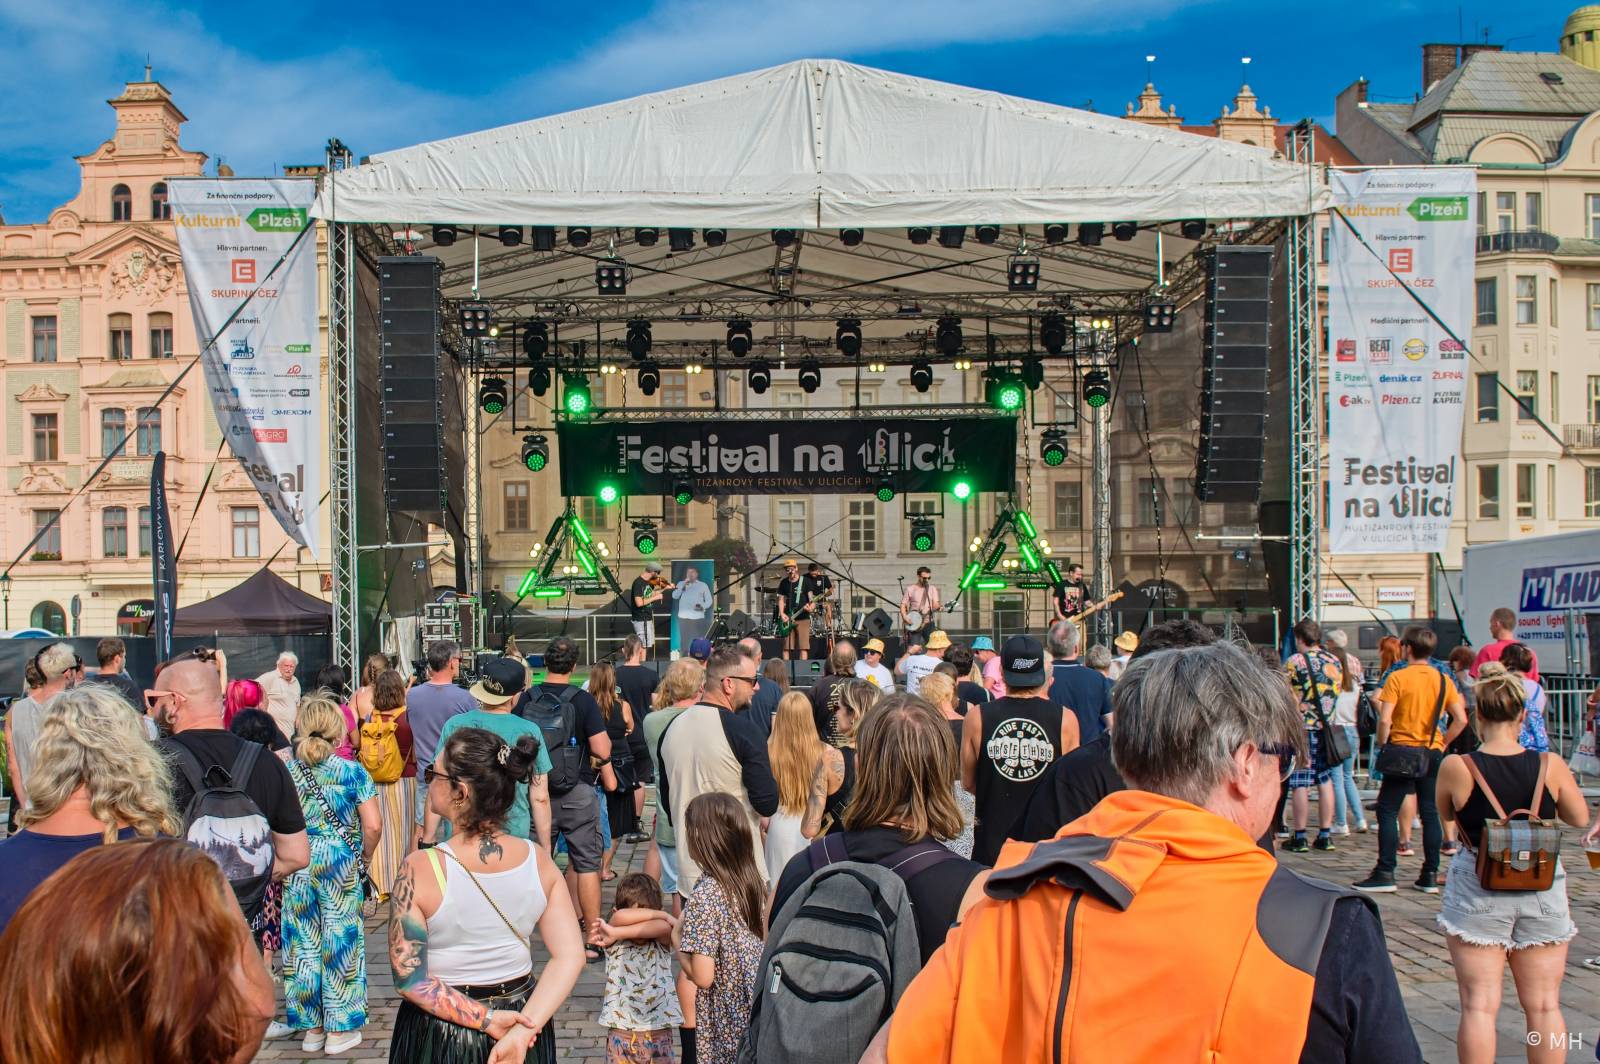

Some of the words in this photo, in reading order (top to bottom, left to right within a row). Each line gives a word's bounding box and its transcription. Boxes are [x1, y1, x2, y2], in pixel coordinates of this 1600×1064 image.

[1419, 199, 1463, 216] Plzeň
[175, 213, 241, 228] Kulturní
[258, 212, 302, 228] Plzeň
[1414, 278, 1434, 288] ČEZ
[211, 289, 255, 298] SKUPINA
[258, 288, 278, 298] ČEZ
[1369, 339, 1391, 352] BEAT
[1382, 394, 1422, 405] Plzen.cz
[617, 433, 779, 474] Festival
[793, 444, 845, 472] na
[1343, 455, 1455, 485] Festival
[758, 476, 804, 487] FESTIVAL
[808, 477, 815, 486] V
[1344, 497, 1379, 518] na
[1389, 485, 1452, 518] Ulicí
[157, 514, 167, 571] KARLOVY
[1518, 615, 1541, 626] sound
[1546, 614, 1565, 628] light
[998, 721, 1018, 736] RIDE
[1021, 722, 1042, 738] FAST
[1000, 764, 1015, 777] DIE
[1018, 765, 1038, 778] LAST
[298, 762, 328, 806] LAGERFE
